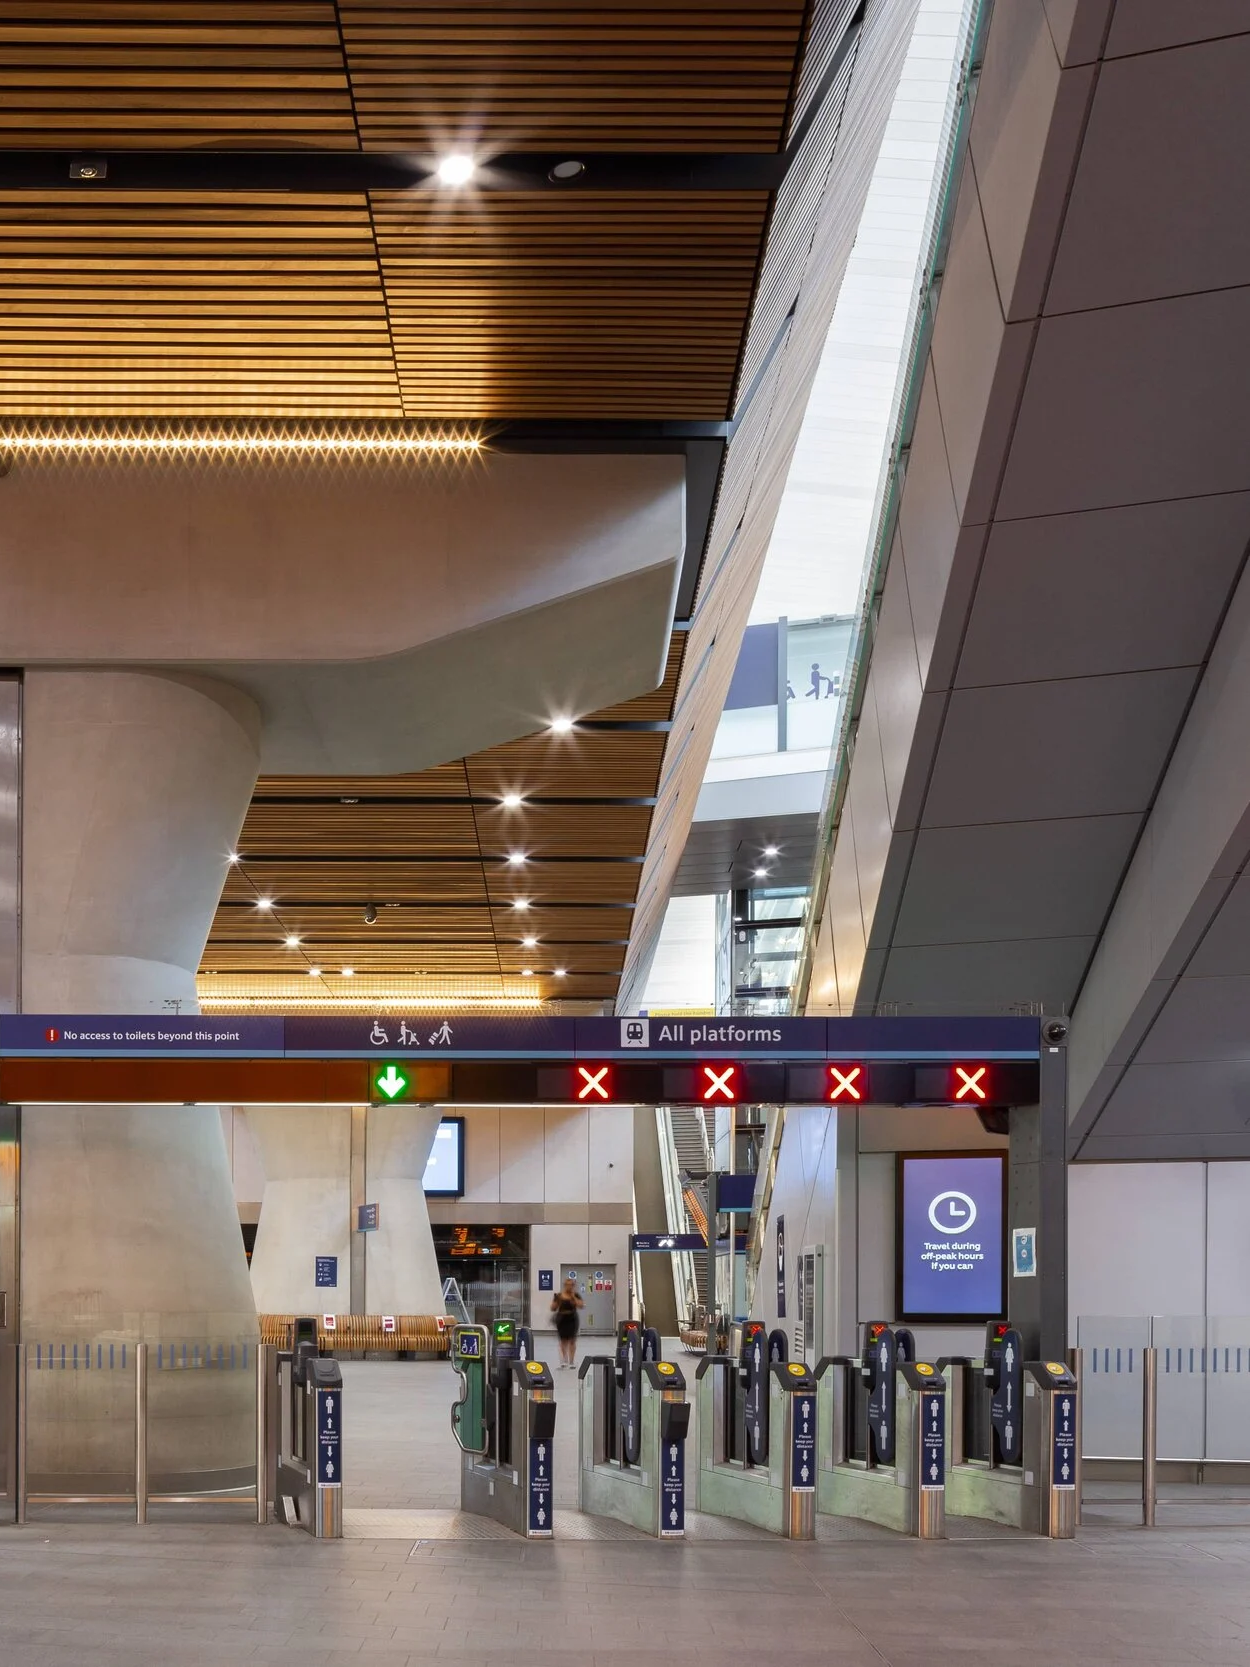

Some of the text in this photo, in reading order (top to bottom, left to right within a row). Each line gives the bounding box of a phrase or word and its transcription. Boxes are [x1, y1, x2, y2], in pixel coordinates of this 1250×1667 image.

[64, 1031, 78, 1040] No
[113, 1032, 123, 1040] to
[126, 1031, 156, 1040] toilets
[158, 1031, 192, 1041] beyond
[195, 1031, 212, 1040] this
[214, 1032, 240, 1041] point
[658, 1025, 782, 1045] All platforms
[924, 1242, 981, 1251] Travel during
[921, 1252, 984, 1262] off-peak hours
[939, 1264, 956, 1272] you
